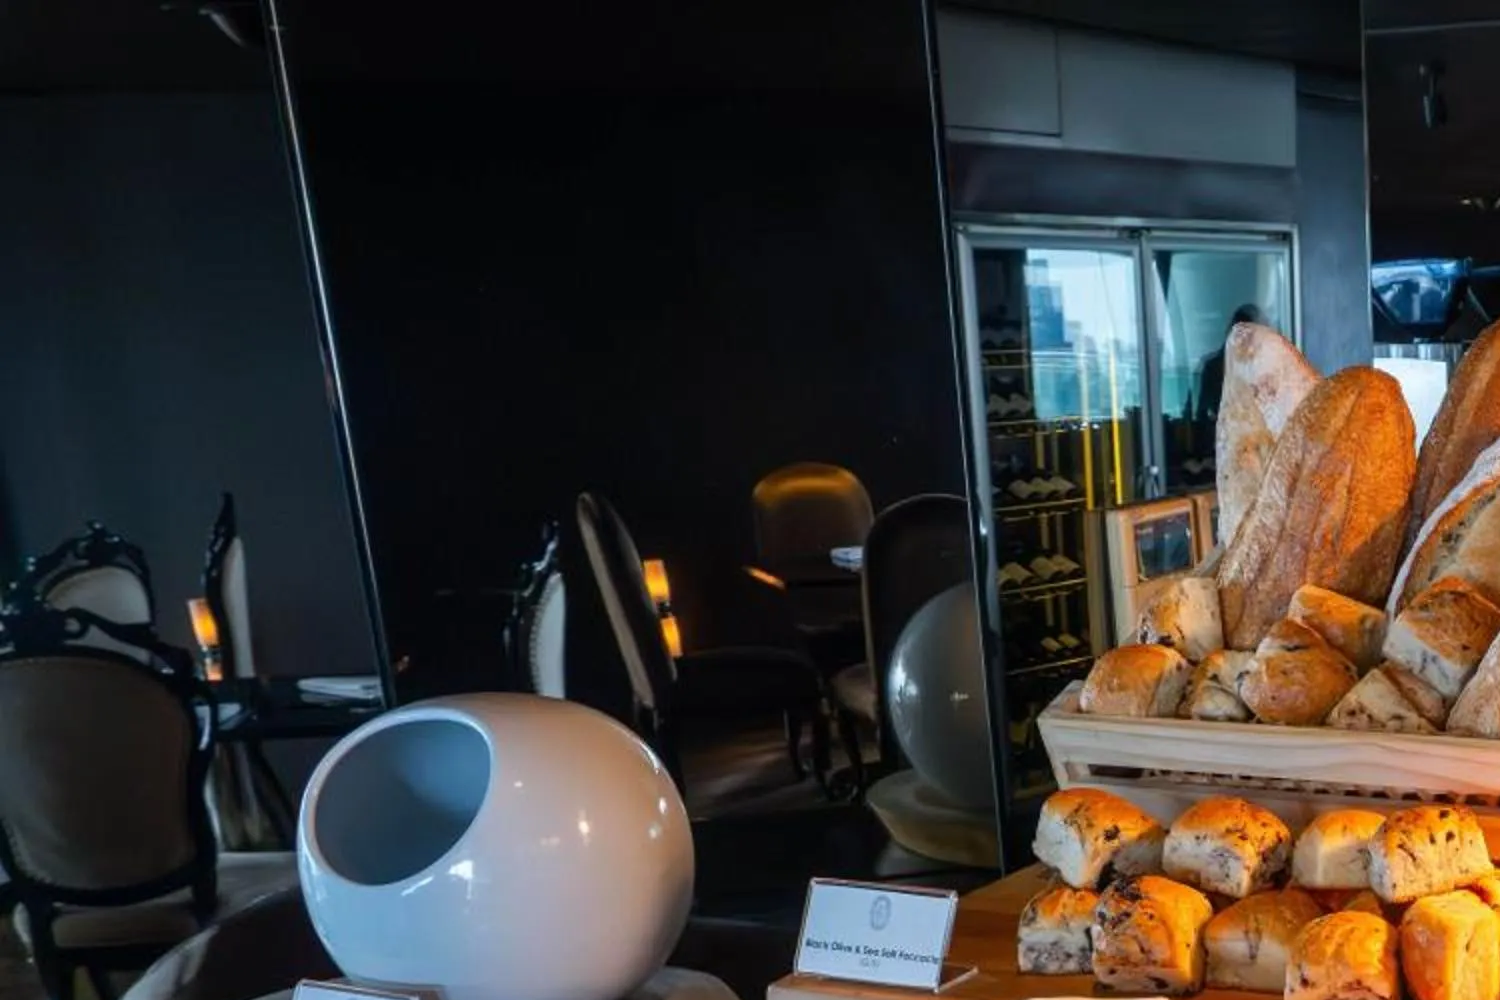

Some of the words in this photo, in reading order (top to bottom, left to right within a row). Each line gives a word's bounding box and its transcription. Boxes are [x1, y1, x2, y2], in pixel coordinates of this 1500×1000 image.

[831, 940, 853, 953] Olive
[855, 944, 861, 954] &
[863, 944, 879, 956] Sea
